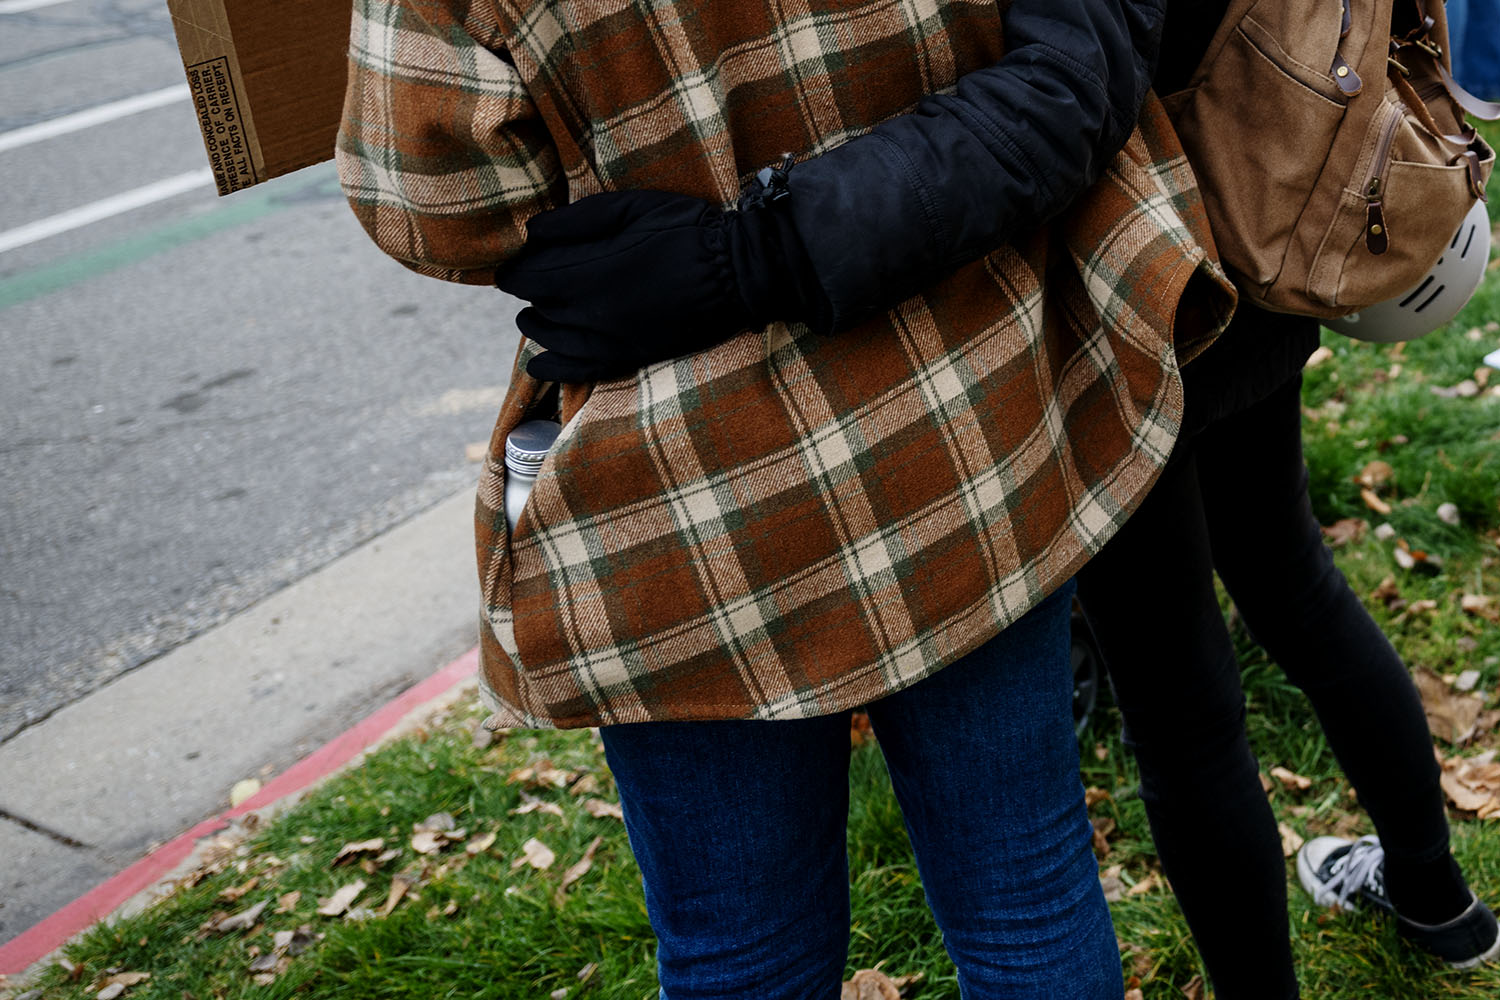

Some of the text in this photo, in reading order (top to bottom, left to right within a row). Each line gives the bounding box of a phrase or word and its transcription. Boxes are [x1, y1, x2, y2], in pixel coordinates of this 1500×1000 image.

[190, 69, 204, 95] LOSS
[201, 65, 221, 115] CARRIER.
[212, 61, 231, 105] RECEIPT.
[197, 96, 218, 151] CONCEALED
[214, 120, 226, 134] OF
[224, 107, 235, 122] ON
[228, 124, 244, 155] FACTS
[211, 152, 224, 171] AND
[237, 156, 249, 175] ALL
